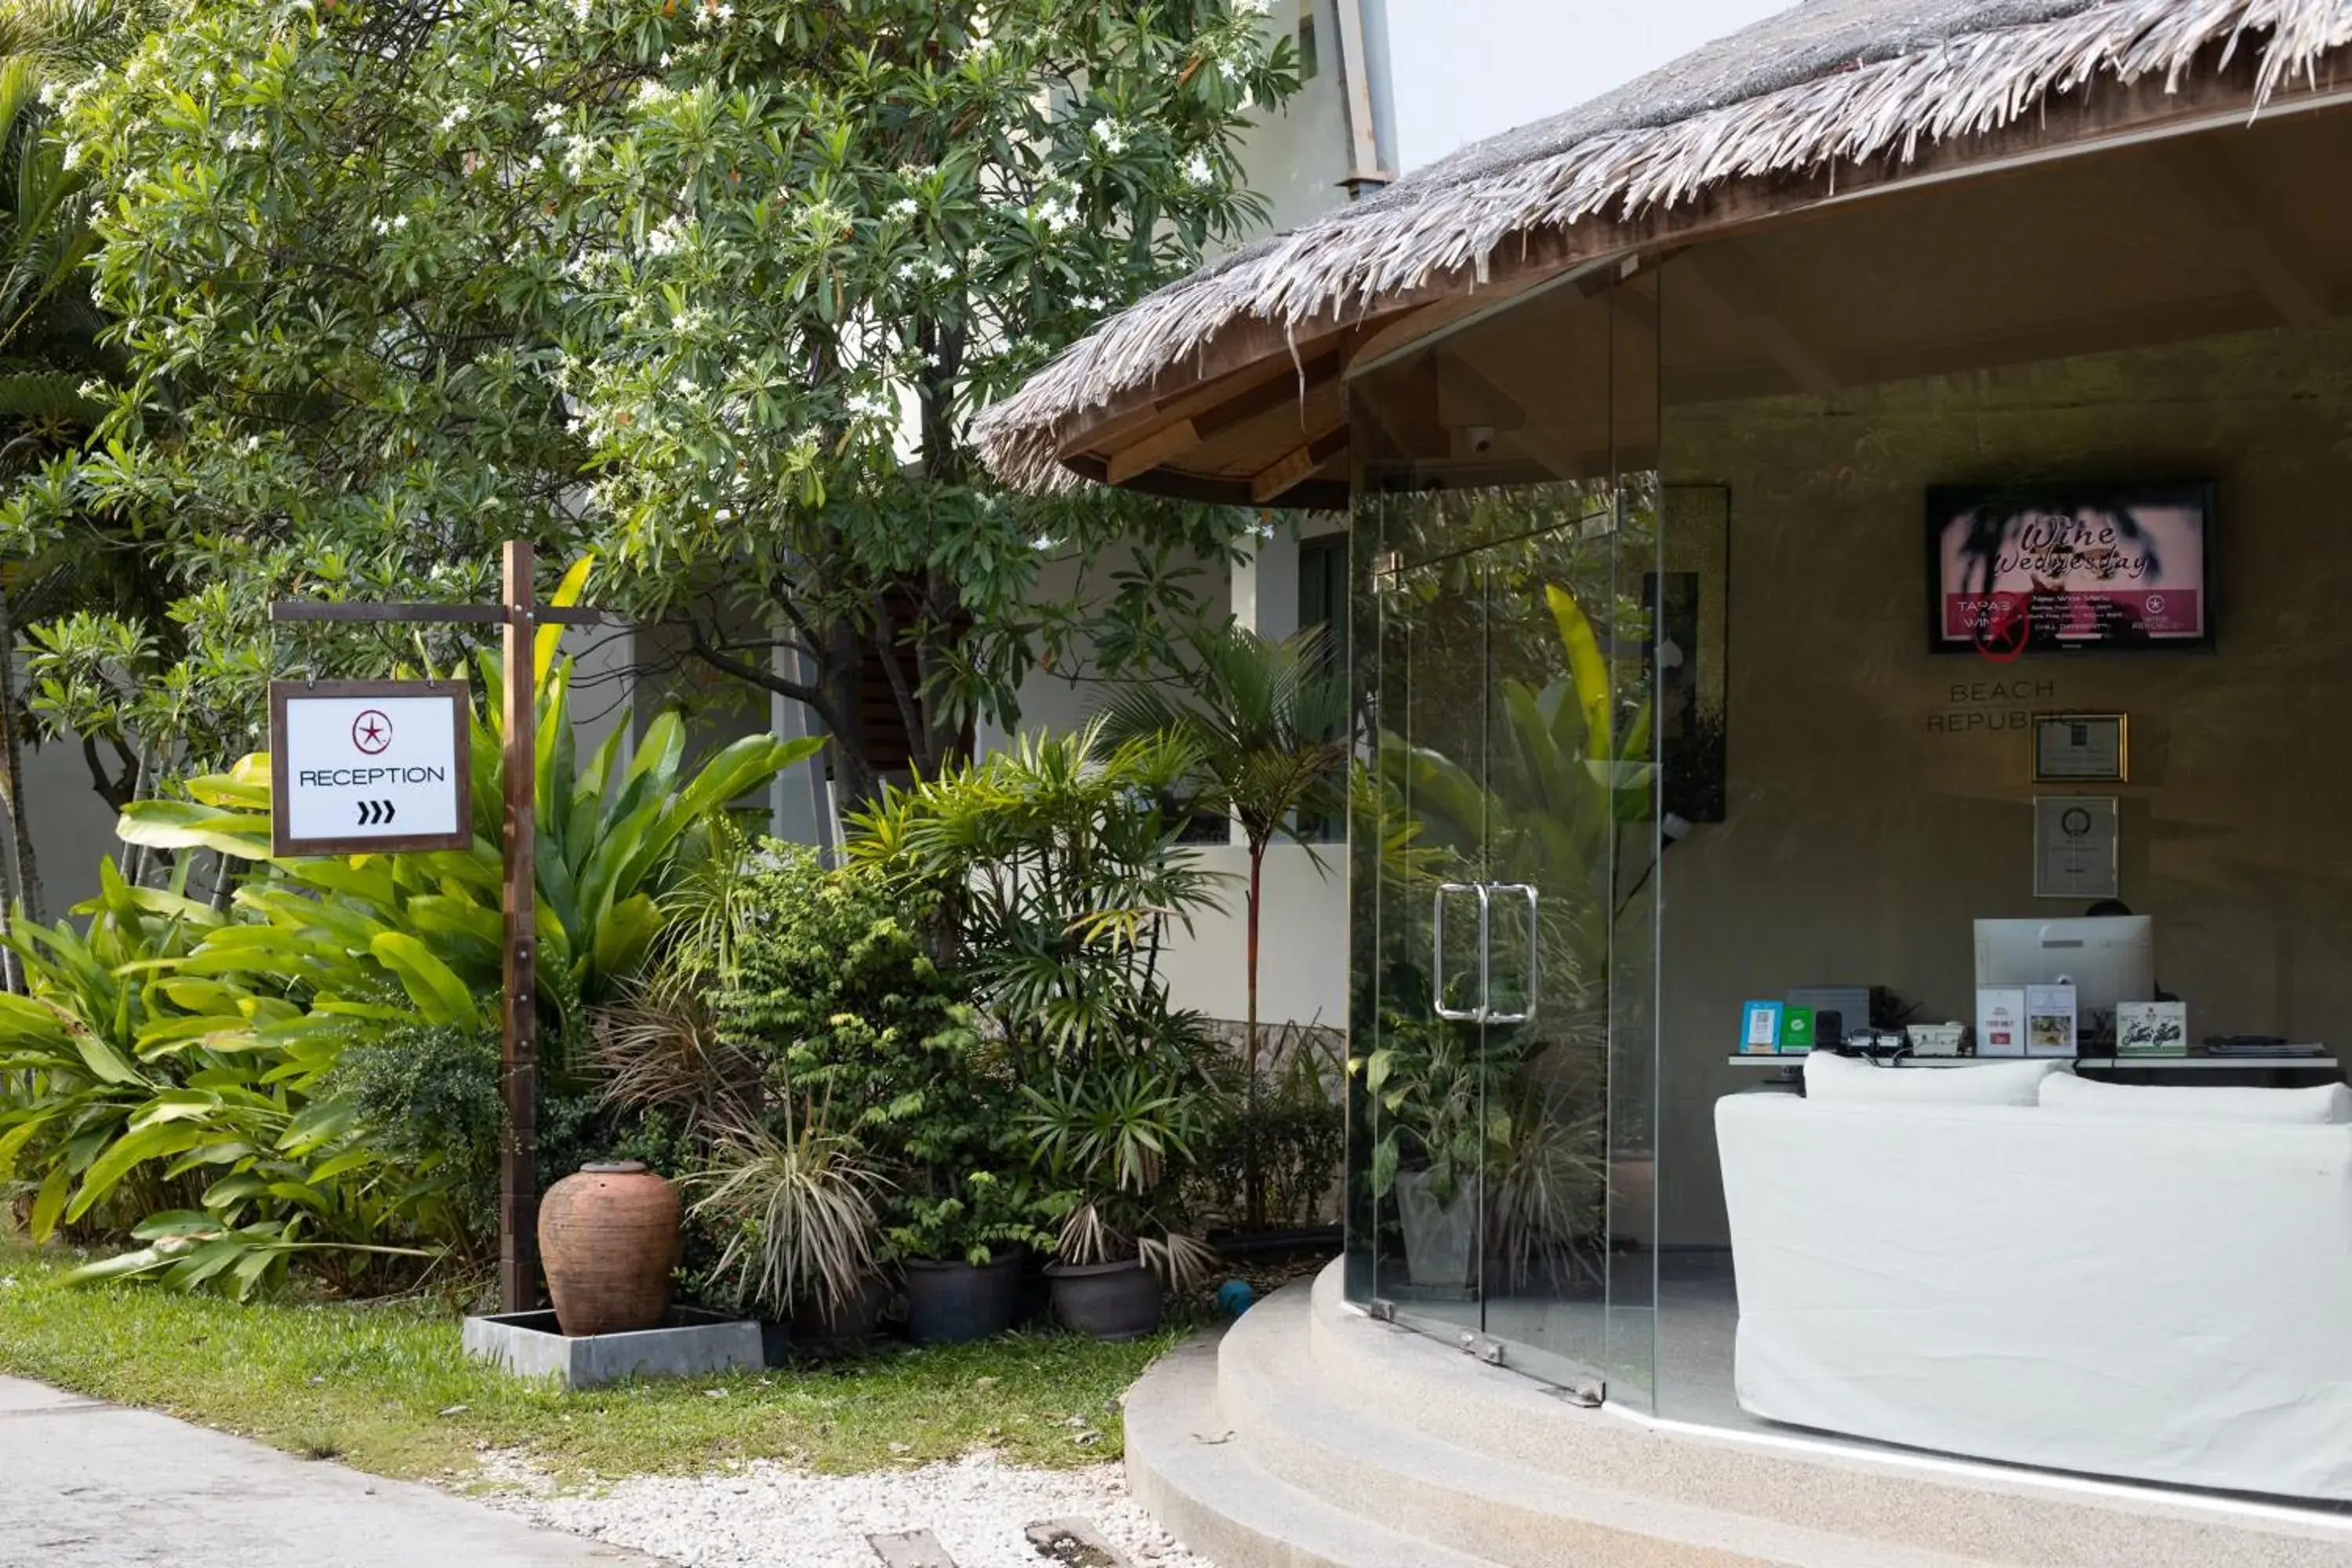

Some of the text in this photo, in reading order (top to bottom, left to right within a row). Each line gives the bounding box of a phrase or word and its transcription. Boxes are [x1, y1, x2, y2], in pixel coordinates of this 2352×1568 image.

[2020, 519, 2117, 550] Wine
[1994, 545, 2148, 579] Wednesday
[1949, 678, 2056, 702] BEACH
[299, 766, 445, 787] RECEPTION
